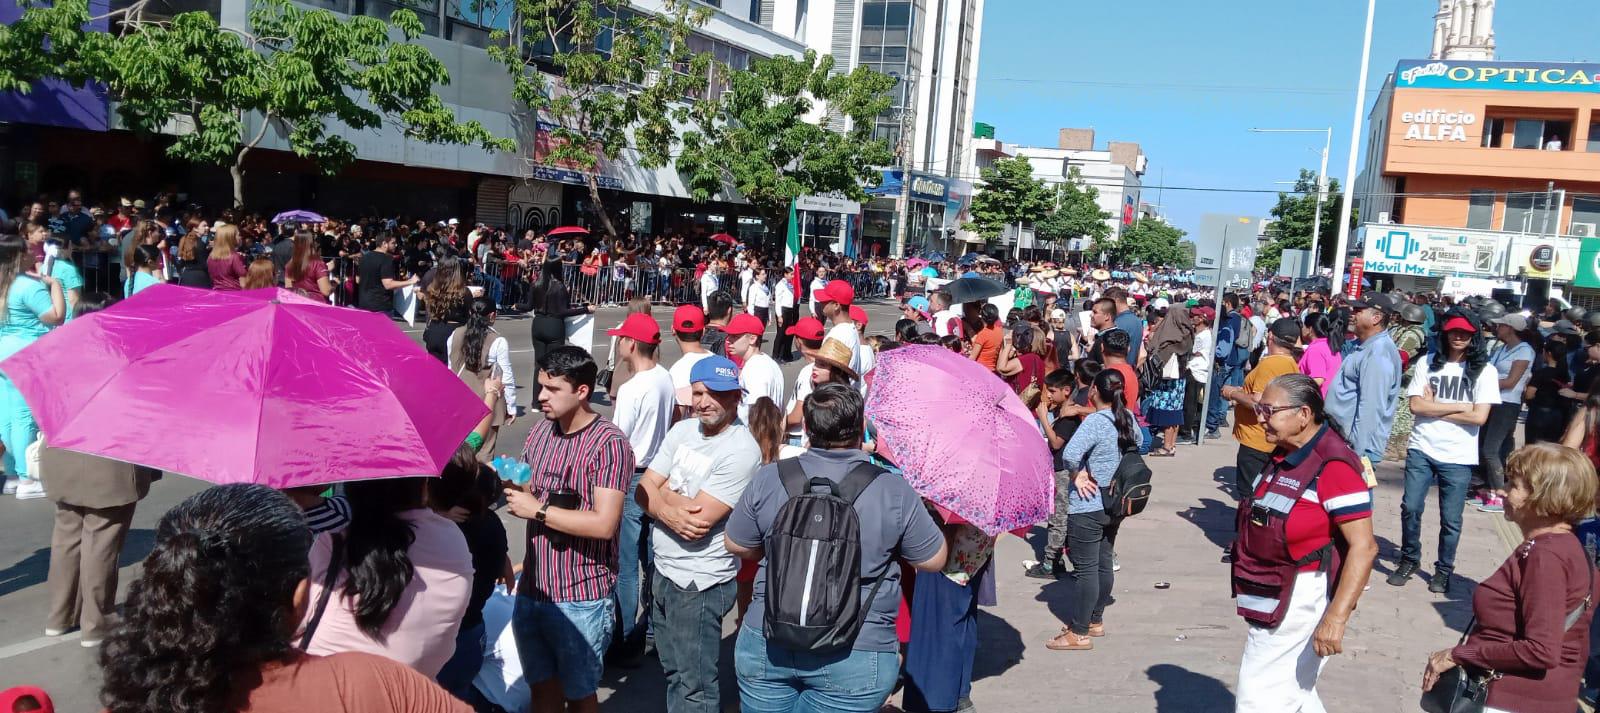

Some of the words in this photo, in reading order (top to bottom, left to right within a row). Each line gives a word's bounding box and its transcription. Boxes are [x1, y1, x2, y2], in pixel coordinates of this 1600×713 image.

[1448, 67, 1594, 84] OPTICA
[1402, 109, 1475, 124] edificio
[1404, 124, 1468, 141] ALFA
[1420, 250, 1437, 262] 24
[1438, 251, 1460, 260] MESES
[1365, 260, 1401, 273] Móvil
[1405, 264, 1425, 274] Mx
